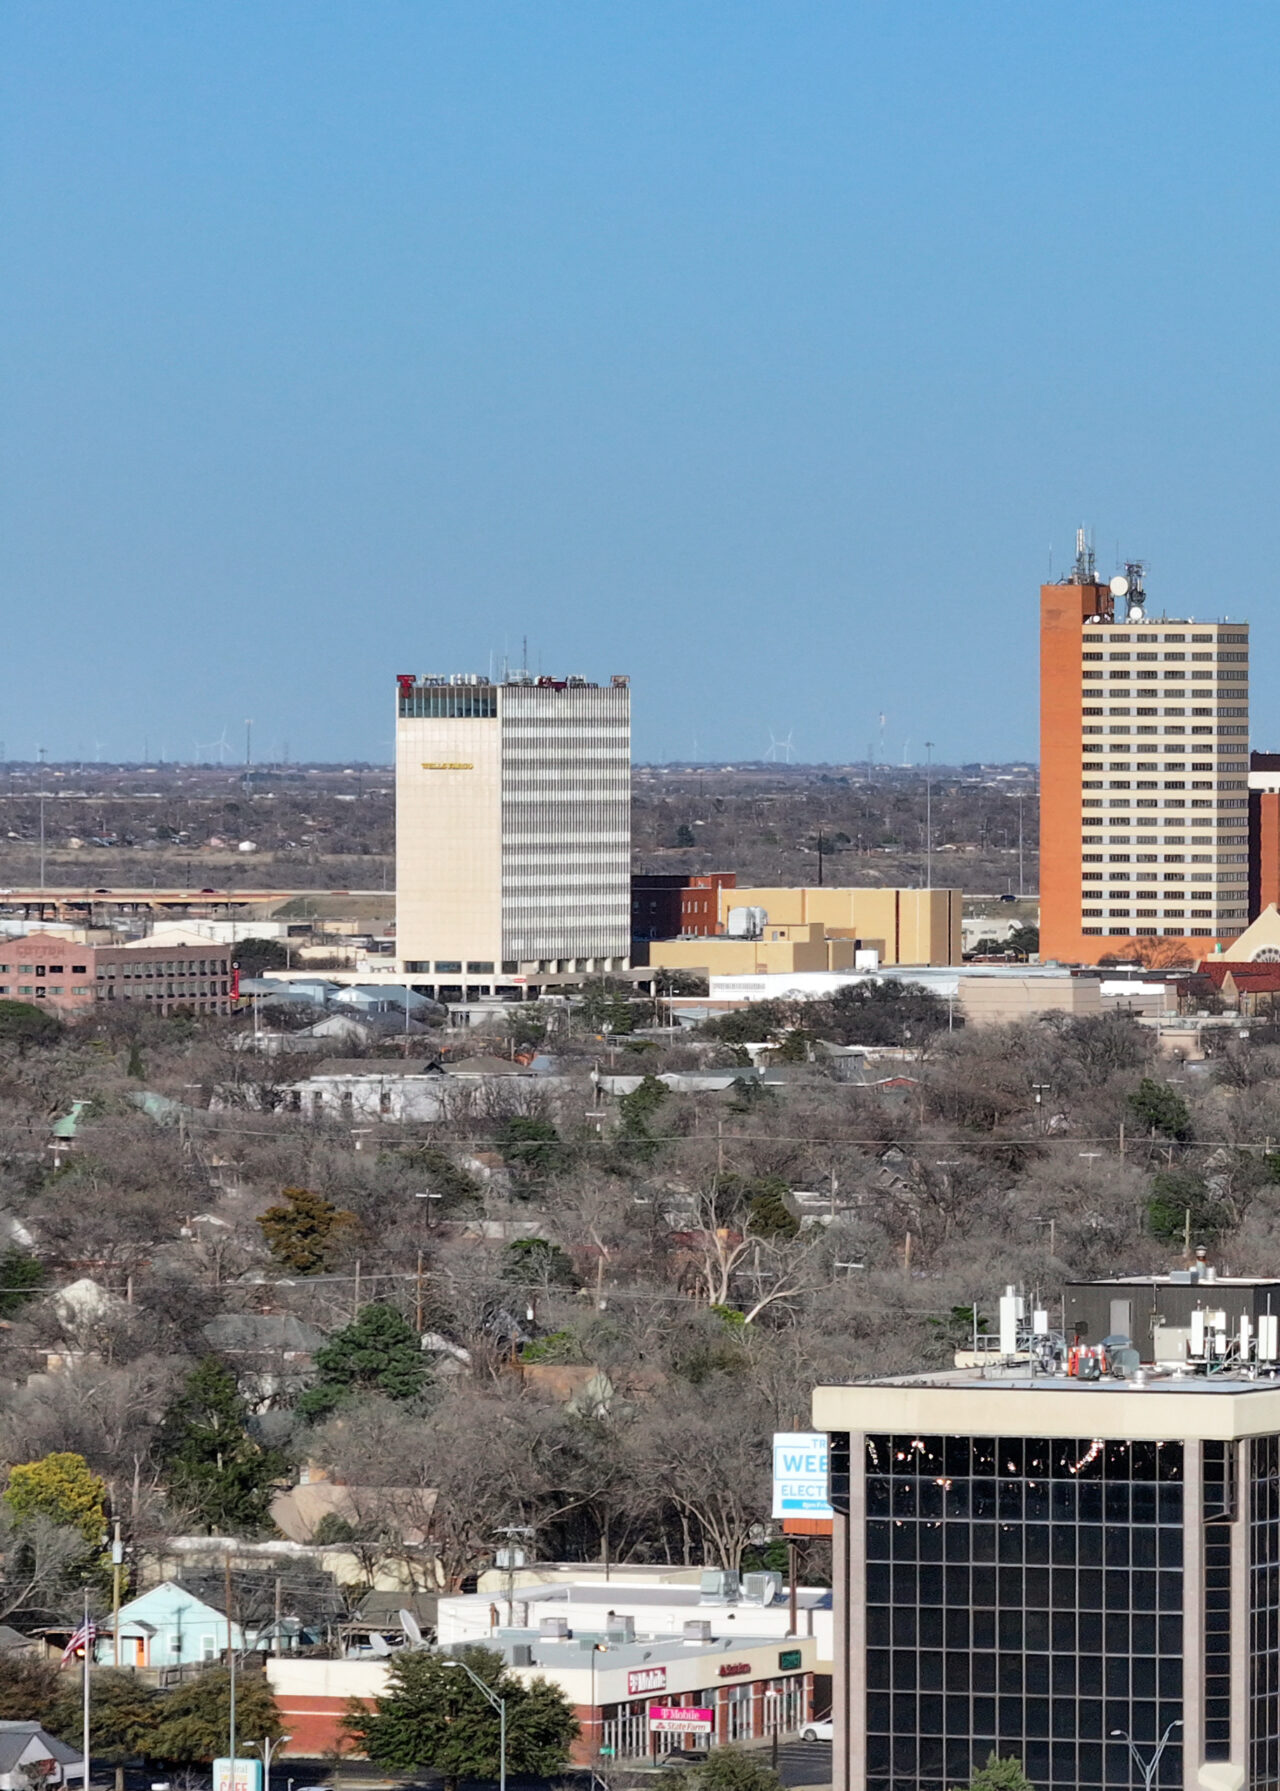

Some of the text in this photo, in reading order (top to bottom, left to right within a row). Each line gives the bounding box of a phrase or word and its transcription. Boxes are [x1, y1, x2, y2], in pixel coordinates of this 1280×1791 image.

[781, 1485, 829, 1497] ELECT
[672, 1709, 700, 1720] Mobile
[667, 1722, 706, 1732] State Farm
